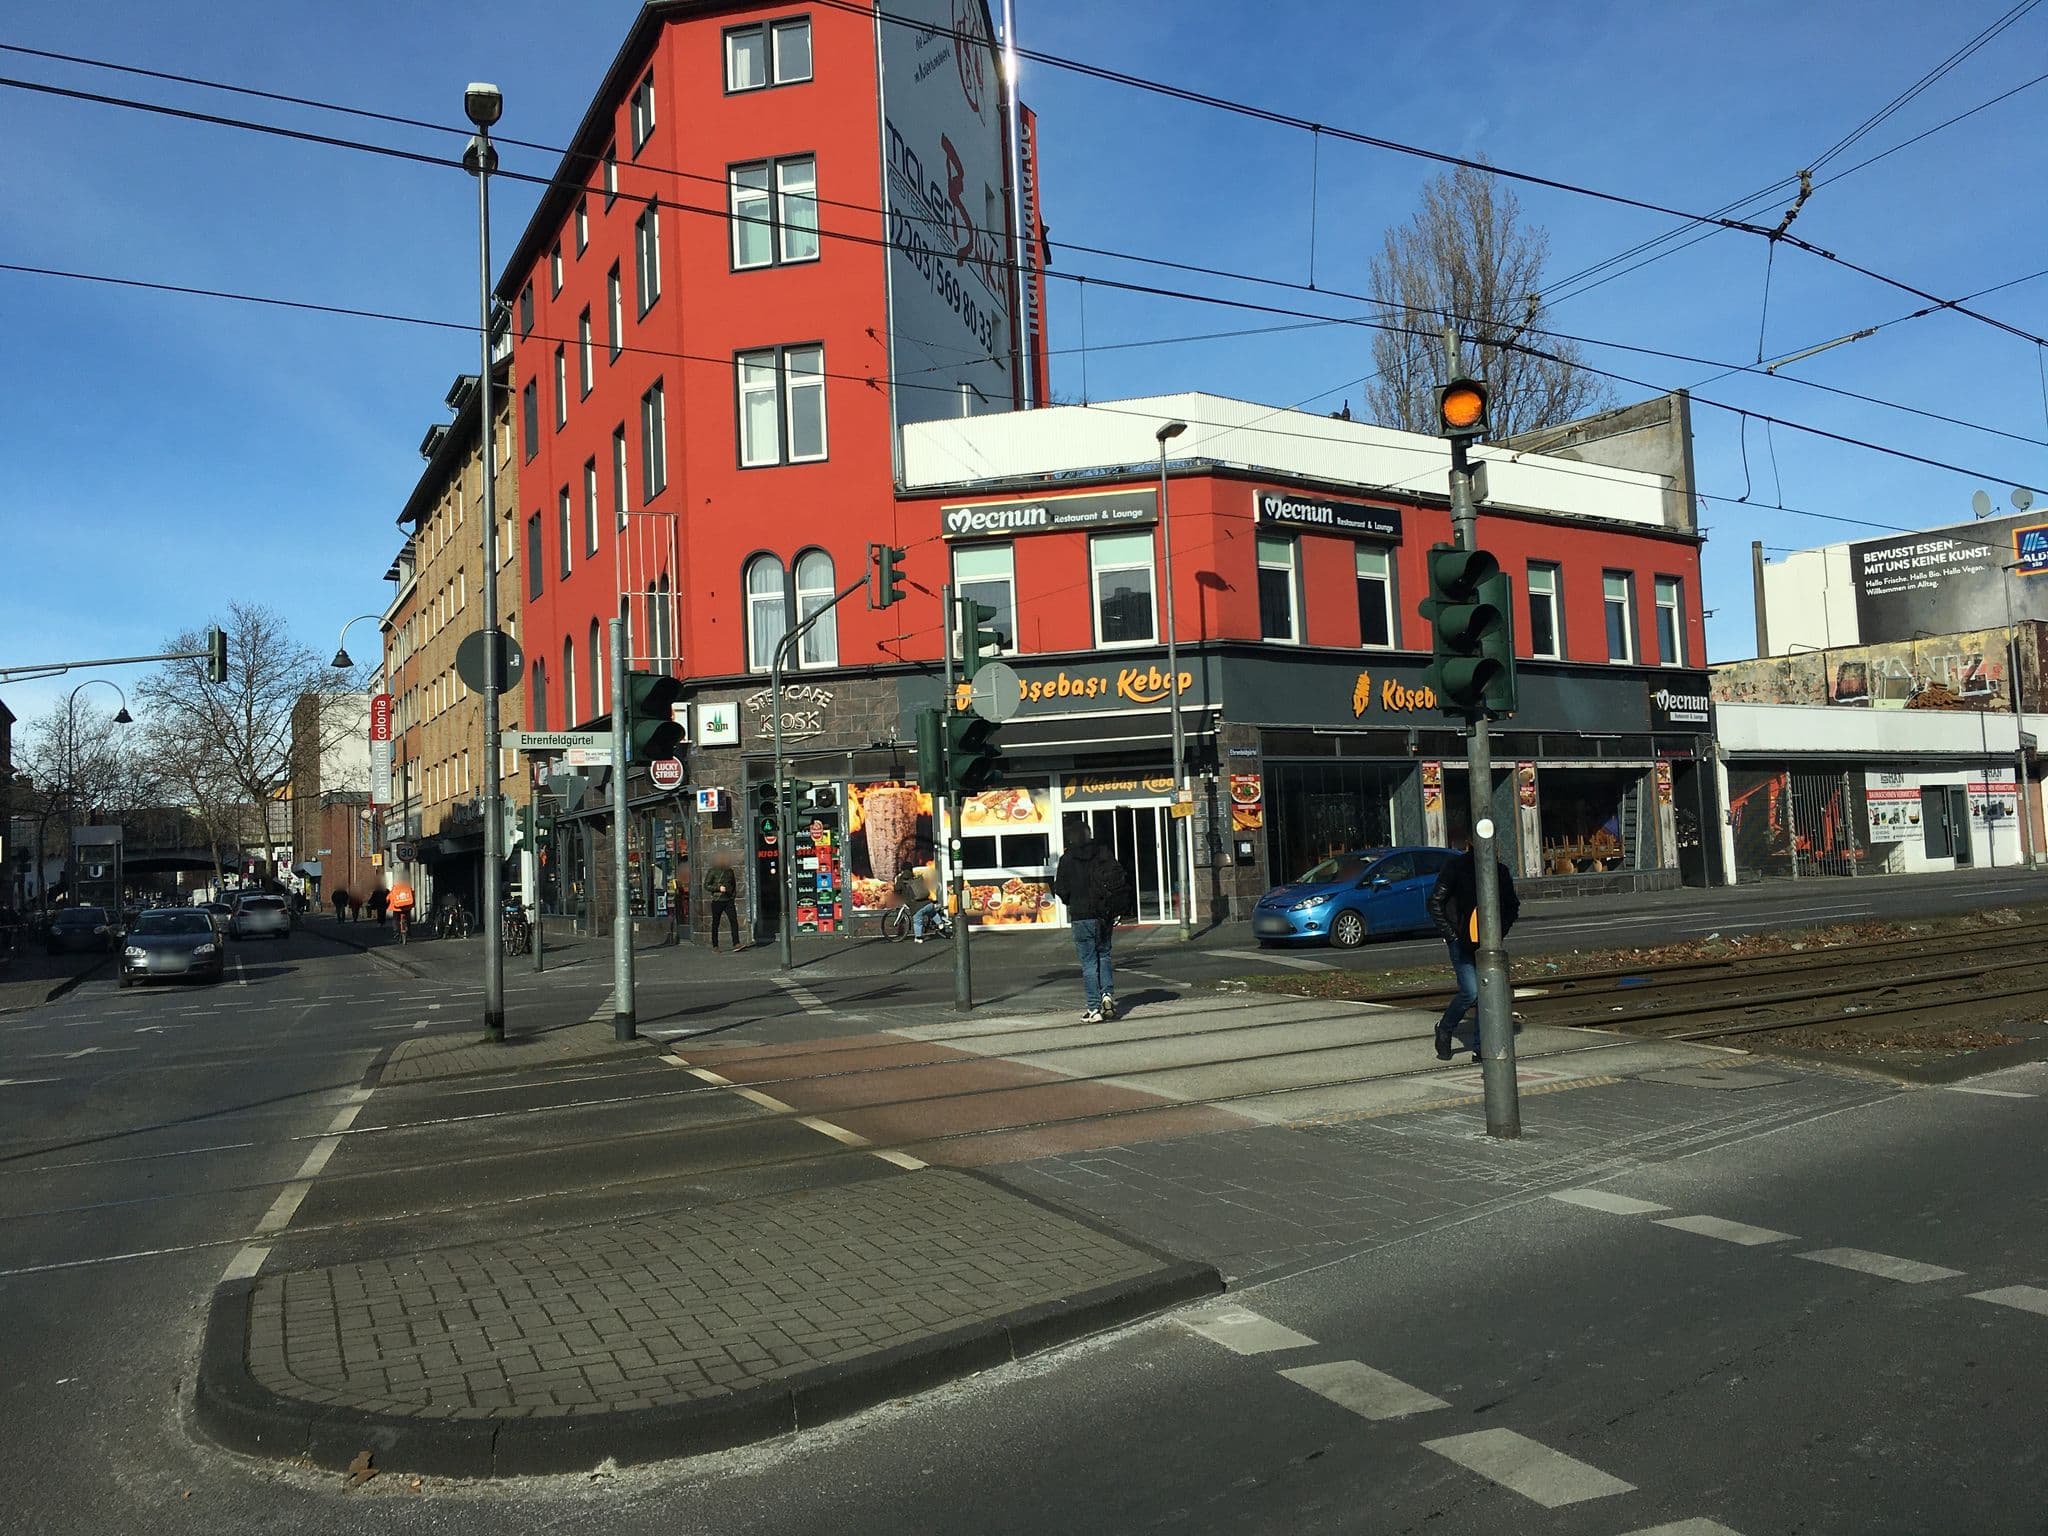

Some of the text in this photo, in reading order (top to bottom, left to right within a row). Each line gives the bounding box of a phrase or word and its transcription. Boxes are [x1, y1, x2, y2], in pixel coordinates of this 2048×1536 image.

[963, 290, 978, 336] 80
[979, 310, 993, 354] 33
[947, 506, 1144, 534] Mecnun Restaurant & Lounge
[1264, 497, 1394, 534] Mecnun Restaurant & Lounge
[1863, 545, 1915, 563] BEWUSST
[1916, 539, 1953, 555] ESSEN
[1864, 546, 1992, 576] MIT UNS KEINE KUNST.
[2023, 551, 2048, 562] ALD
[1865, 564, 1986, 588] Hallo Frische. Hallo Bio. Hallo Vegan.
[1865, 585, 1907, 596] Willkommen
[1917, 580, 1940, 589] Alltag.
[1019, 666, 1193, 703] öşebaşı Kebap
[1381, 678, 1438, 712] Köşeb
[1656, 688, 1709, 711] Mecnun
[373, 700, 387, 740] colonia
[760, 710, 820, 732] KOSK
[521, 734, 594, 747] Ehrenfeldgürtel
[376, 741, 388, 799] zahnklinik
[655, 770, 680, 779] STRIKE
[656, 763, 679, 771] LUCKY
[1141, 773, 1175, 793] Keba
[401, 848, 414, 857] 30
[758, 850, 778, 858] KIOS
[89, 865, 103, 878] U
